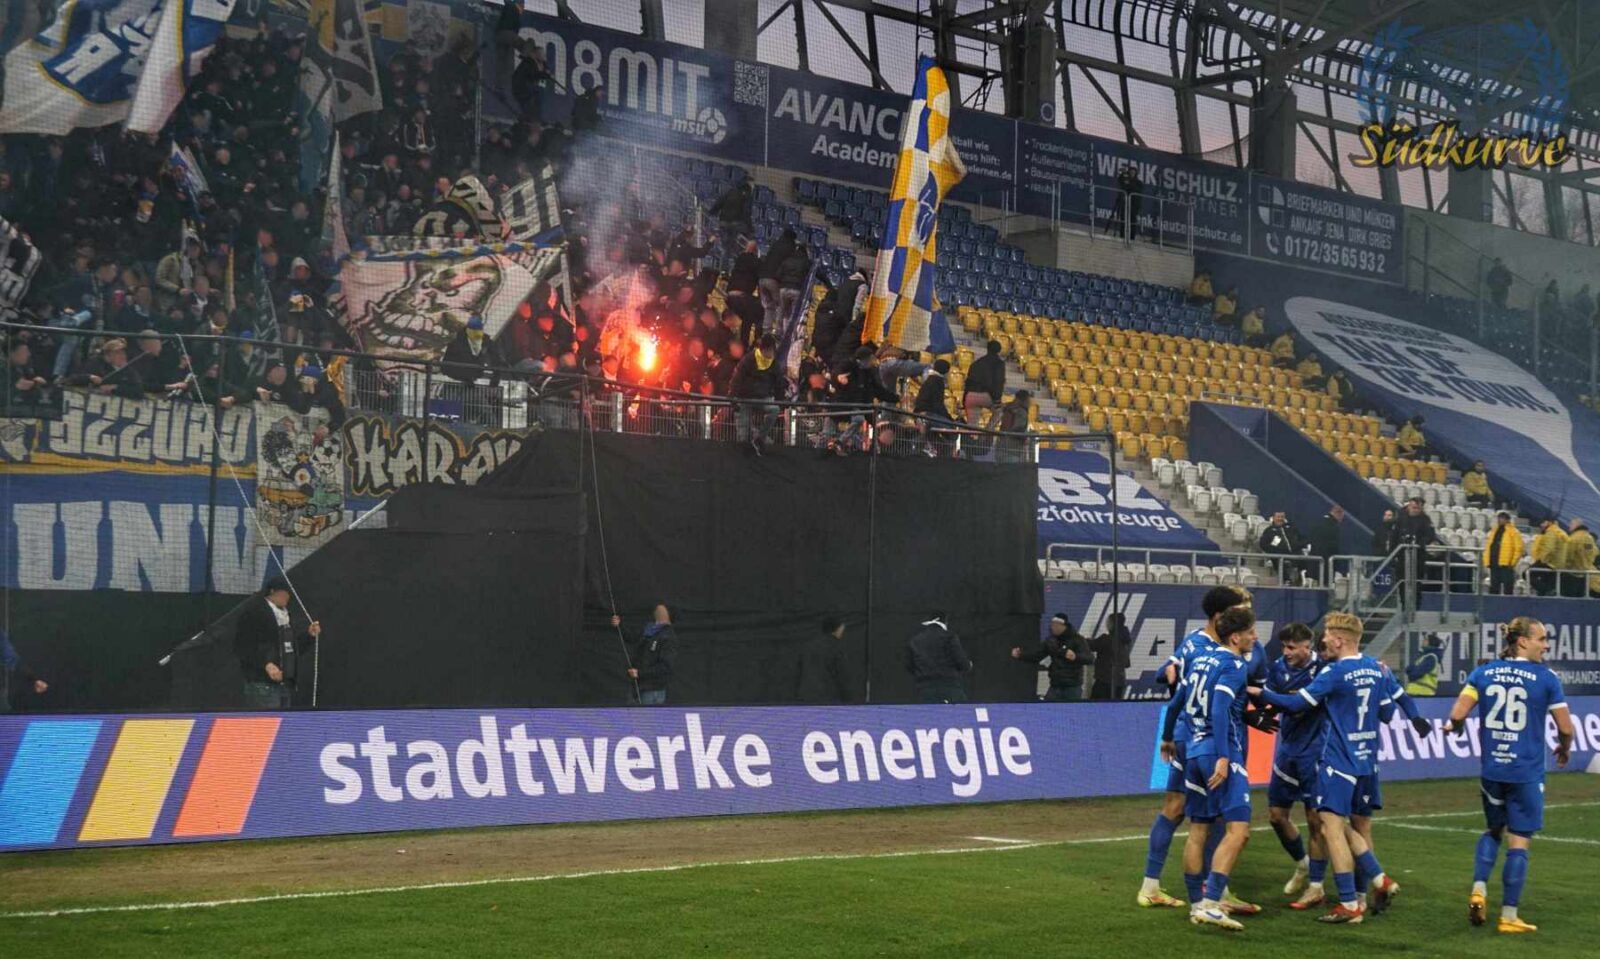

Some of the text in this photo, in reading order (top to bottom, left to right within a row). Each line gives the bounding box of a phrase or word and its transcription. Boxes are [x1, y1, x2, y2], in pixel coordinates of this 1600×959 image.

[774, 87, 904, 142] AVANC
[811, 134, 899, 169] Academ
[1037, 467, 1166, 511] BZ
[1037, 504, 1182, 532] zfahrzeuge
[1186, 672, 1208, 717] 24
[1493, 674, 1524, 686] JENA
[1356, 688, 1371, 731] 7
[1485, 684, 1528, 732] 26
[319, 706, 1034, 805] stadtwerke energie
